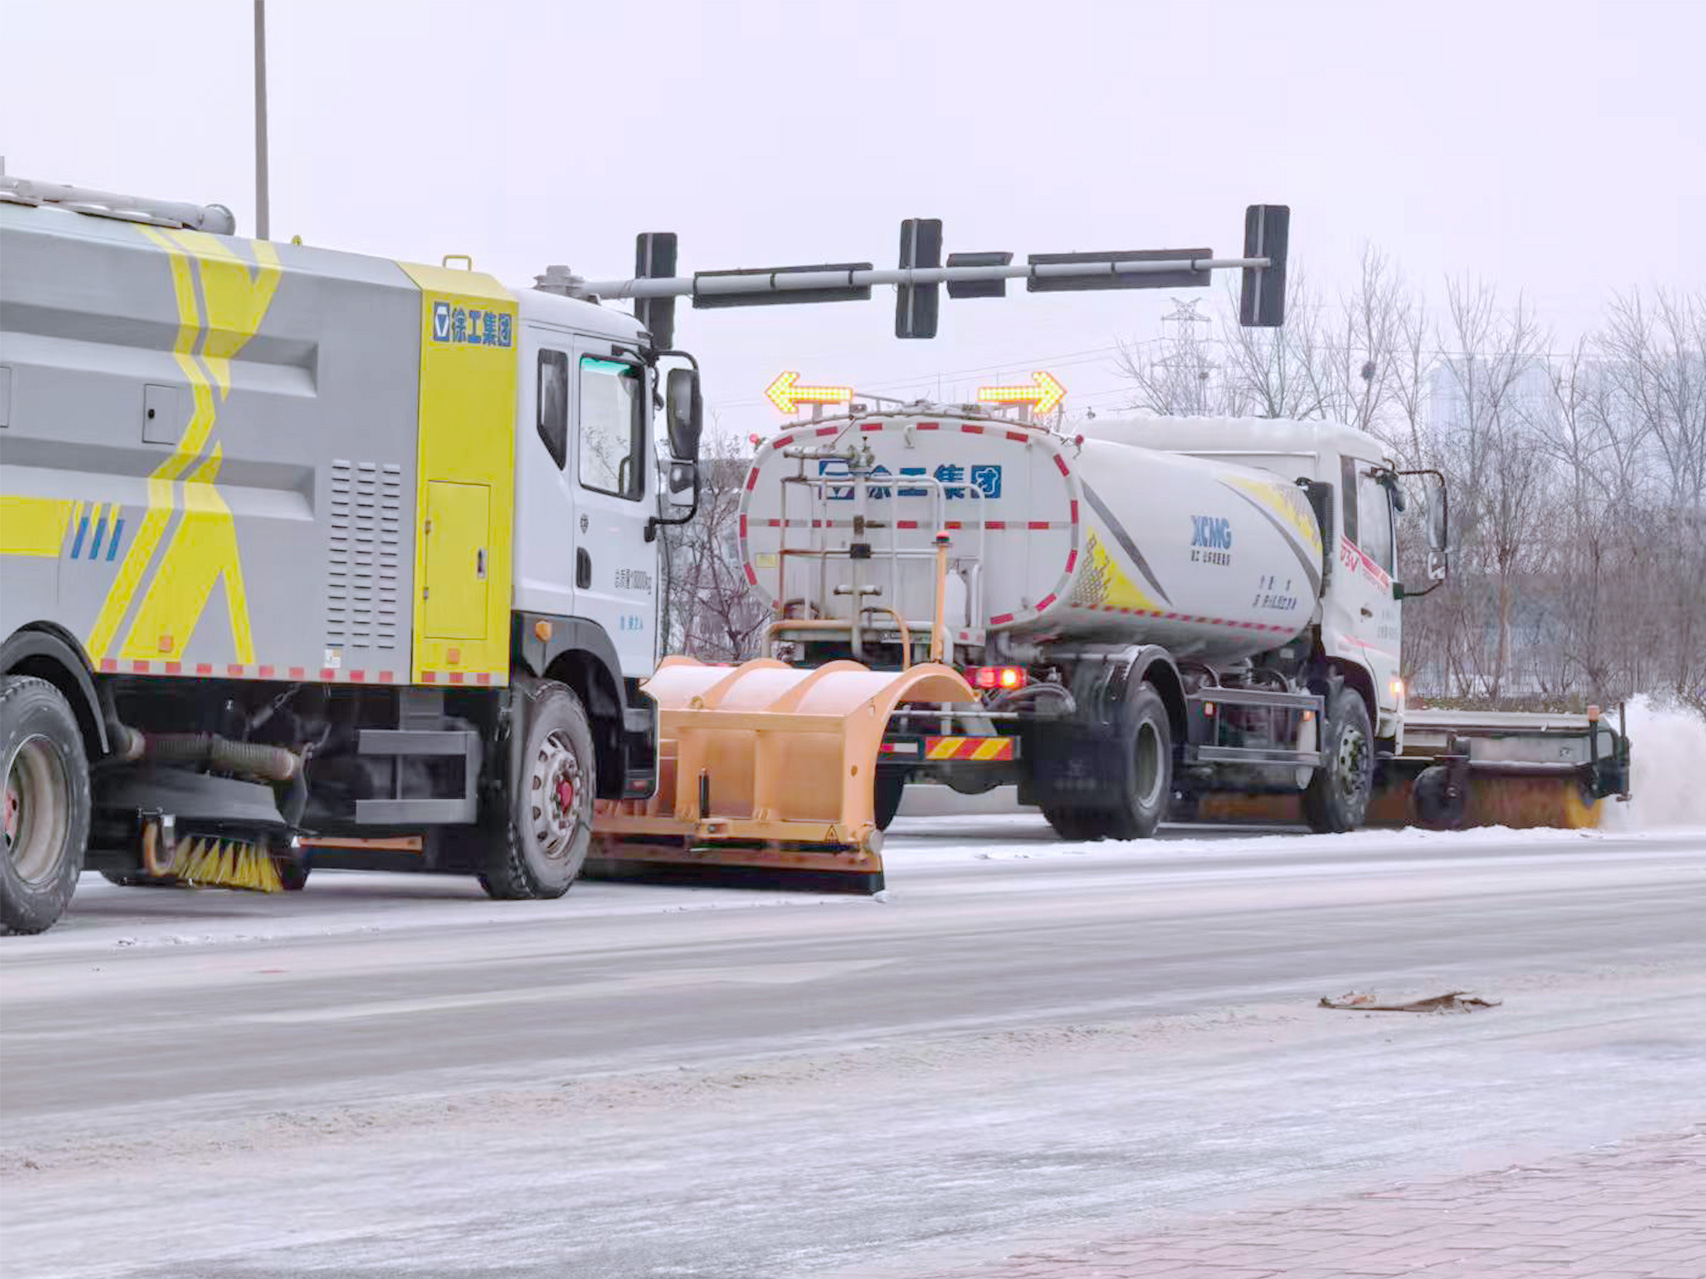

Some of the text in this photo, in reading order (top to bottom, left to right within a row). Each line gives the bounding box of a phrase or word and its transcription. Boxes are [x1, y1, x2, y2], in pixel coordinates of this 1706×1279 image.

[452, 307, 512, 347] 徐工集团
[1190, 514, 1232, 550] XCMG
